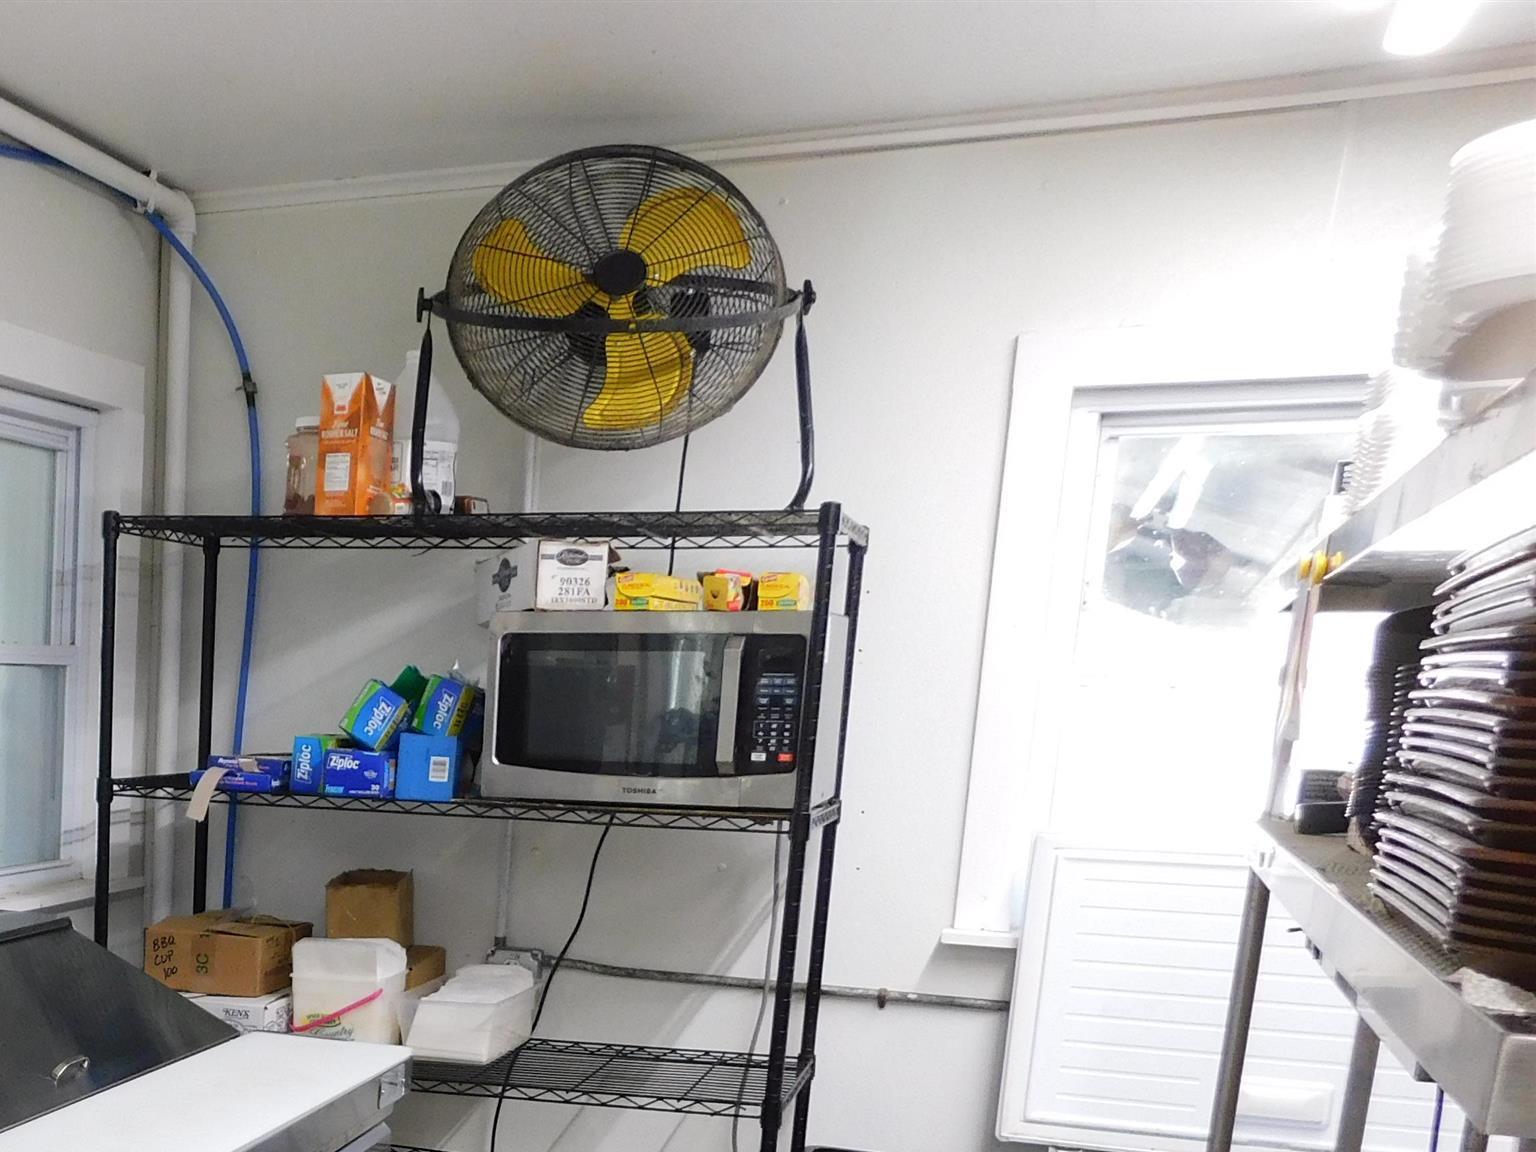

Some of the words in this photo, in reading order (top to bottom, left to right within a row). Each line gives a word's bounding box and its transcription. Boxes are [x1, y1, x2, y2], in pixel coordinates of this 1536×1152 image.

[560, 577, 591, 586] 90326
[364, 701, 392, 736] Ziploc
[434, 693, 454, 729] Ziploc
[297, 744, 312, 780] Ziploc
[329, 755, 360, 770] Ziploc
[153, 935, 176, 952] BBQ
[154, 949, 174, 966] CUP
[163, 966, 178, 980] 100
